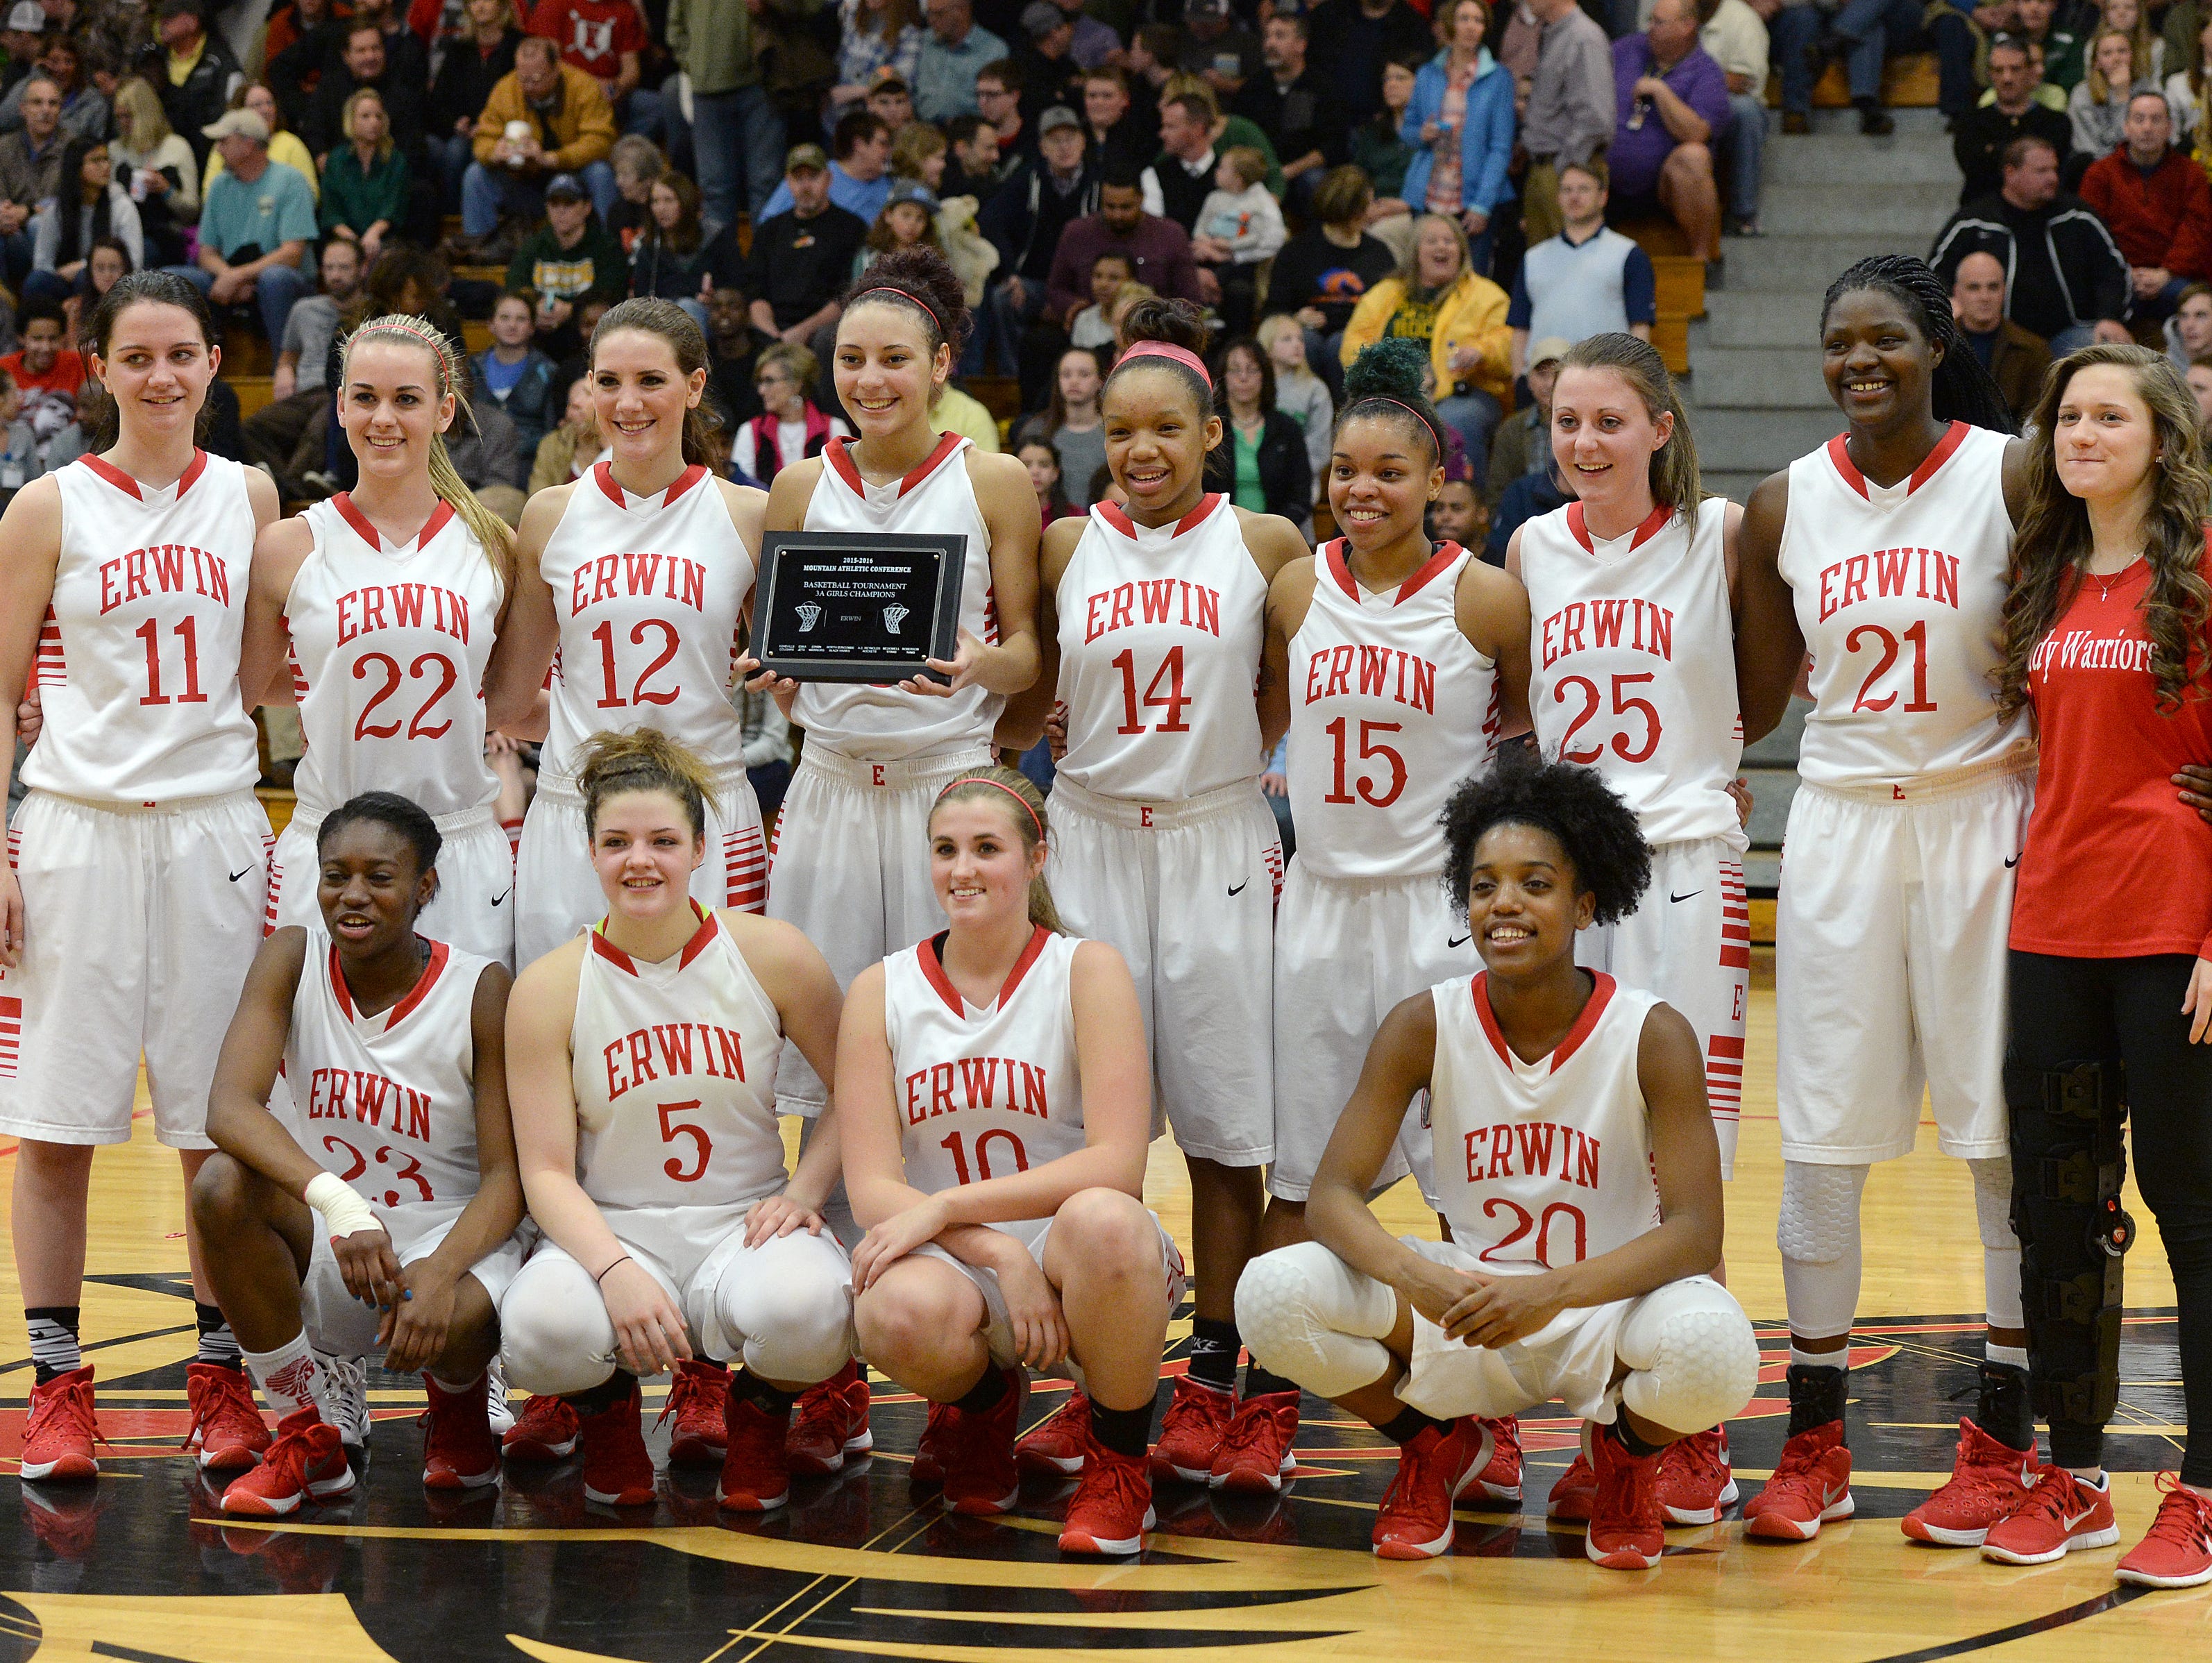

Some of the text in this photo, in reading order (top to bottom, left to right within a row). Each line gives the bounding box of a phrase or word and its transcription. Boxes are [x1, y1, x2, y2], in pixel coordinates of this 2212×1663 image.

[100, 544, 229, 616] ERWIN
[337, 583, 469, 648] ERWIN
[572, 554, 707, 618] ERWIN
[1085, 579, 1219, 646] ERWIN
[1820, 548, 1960, 625] ERWIN
[135, 615, 208, 706] 11
[592, 618, 681, 709] 12
[1543, 599, 1674, 671] ERWIN
[1846, 620, 1938, 714] 21
[2061, 629, 2159, 673] Warriors
[352, 652, 457, 741] 22
[1112, 645, 1192, 735] 14
[1306, 645, 1437, 716] ERWIN
[1554, 672, 1663, 764] 25
[872, 765, 886, 787] E
[1324, 716, 1408, 808] 15
[1140, 807, 1153, 827] E
[1732, 984, 1743, 1021] E
[603, 1022, 746, 1103] ERWIN
[906, 1057, 1049, 1126] ERWIN
[309, 1068, 432, 1144] ERWIN
[657, 1099, 713, 1183] 5
[323, 1135, 434, 1208] 23
[940, 1129, 1029, 1185] 10
[1464, 1122, 1601, 1190] ERWIN
[1479, 1197, 1587, 1269] 20
